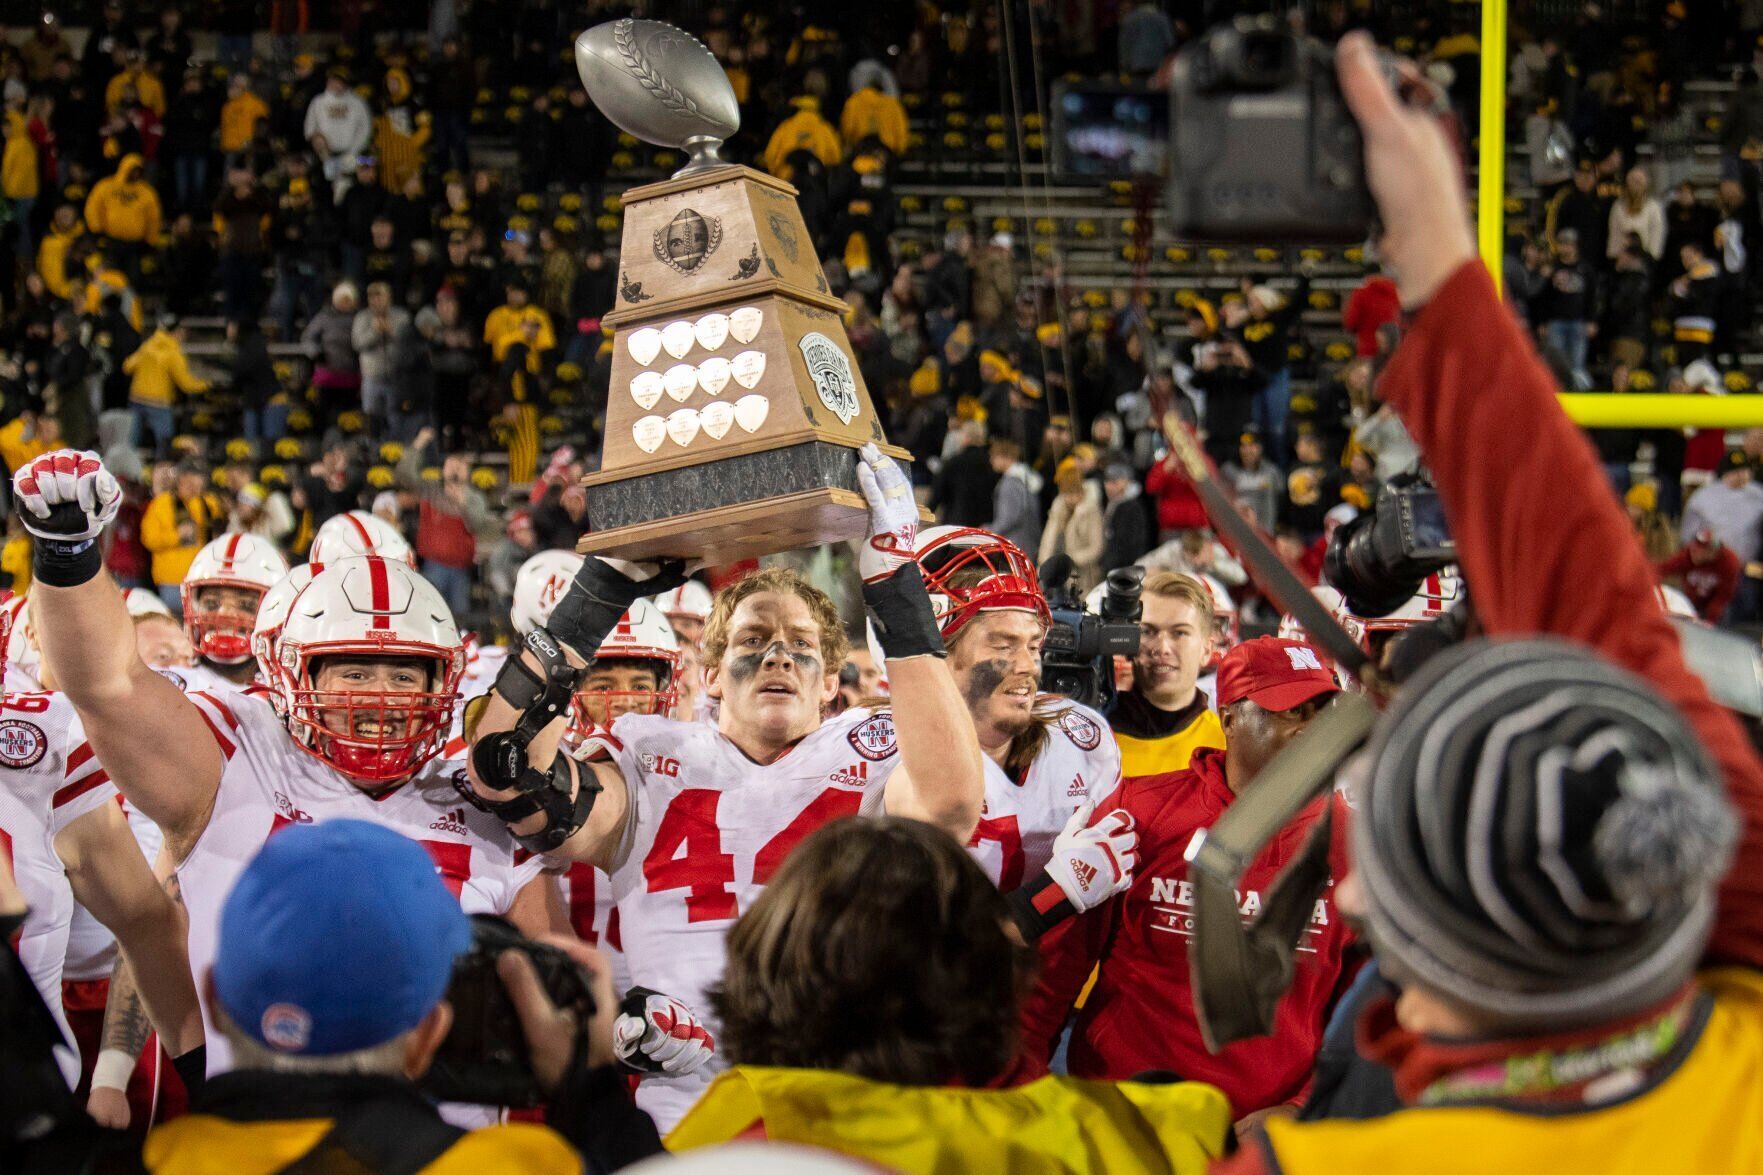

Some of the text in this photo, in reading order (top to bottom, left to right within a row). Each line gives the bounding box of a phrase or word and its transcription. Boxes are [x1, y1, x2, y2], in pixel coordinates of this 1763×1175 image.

[1283, 646, 1323, 671] N
[860, 728, 895, 738] HUSKERS
[829, 773, 867, 787] adidas
[429, 820, 468, 837] adidas
[1070, 858, 1090, 892] adidas
